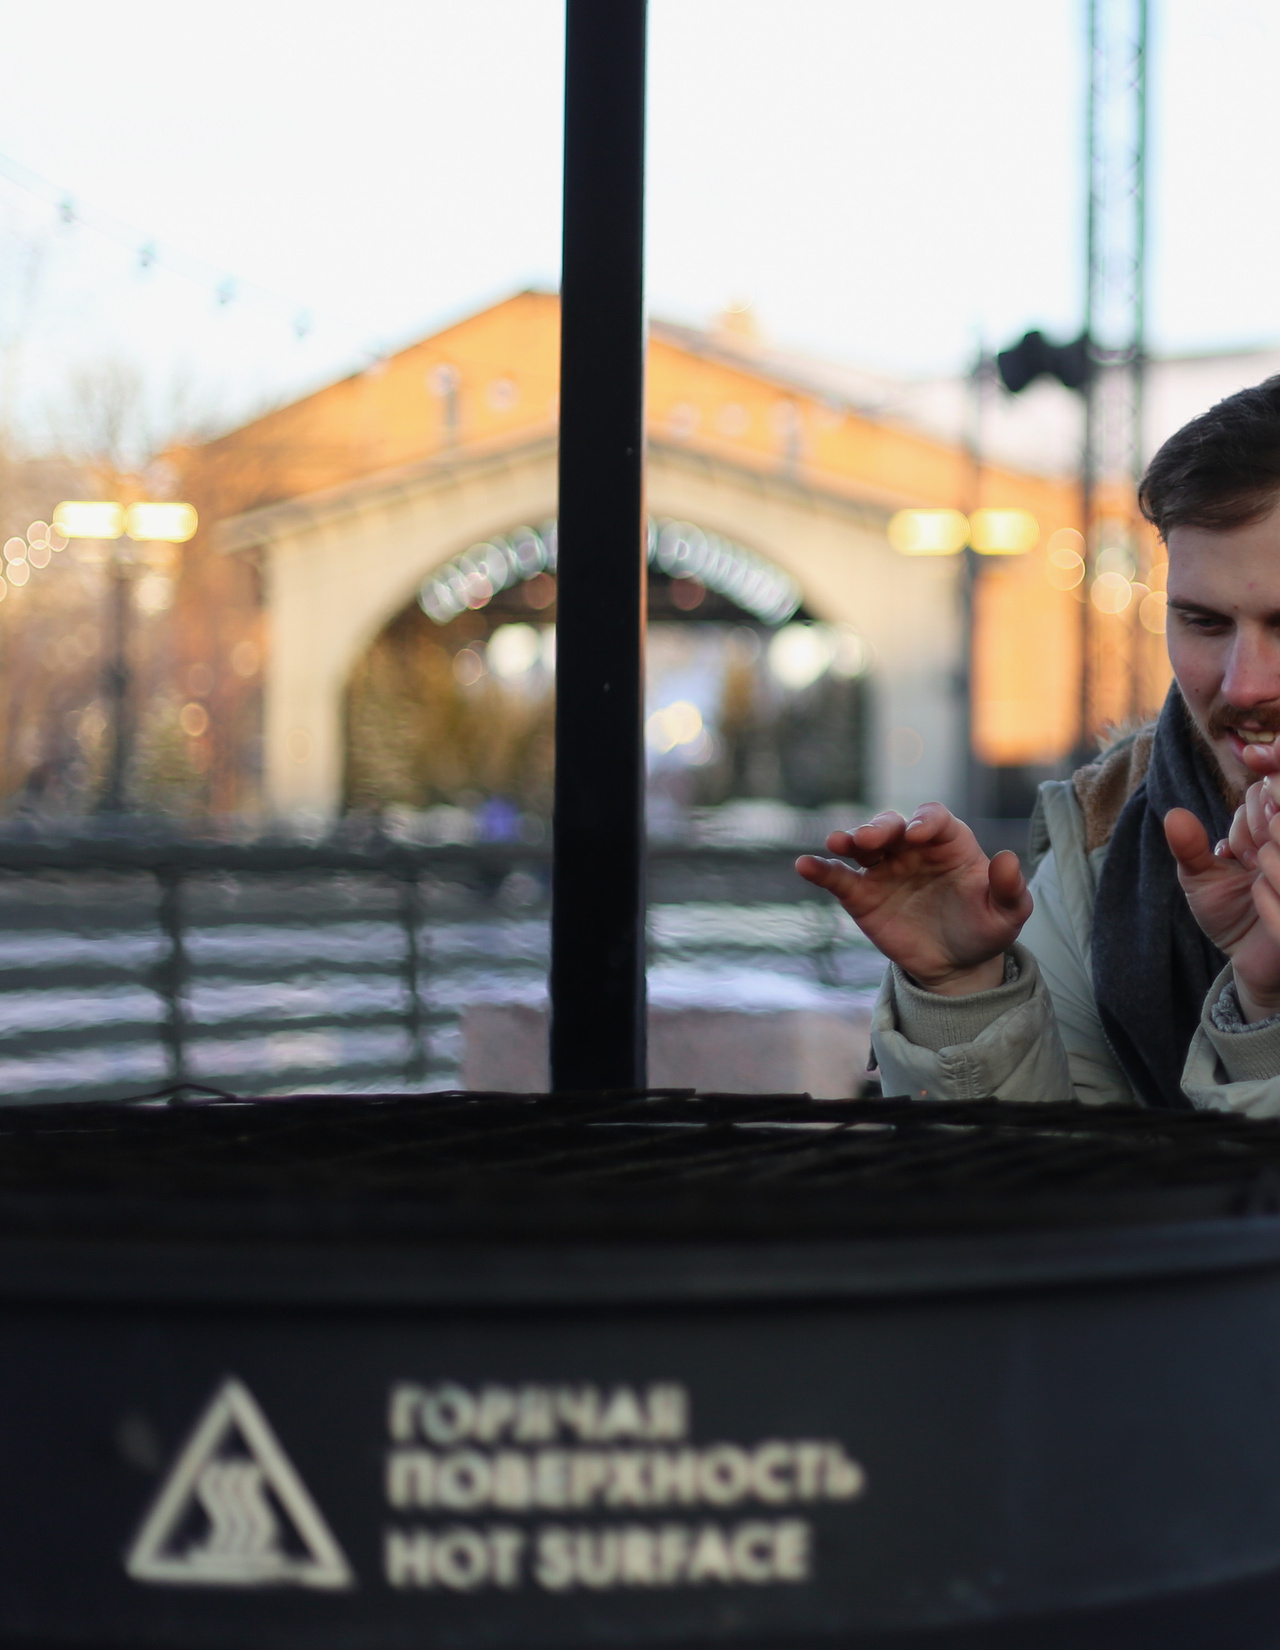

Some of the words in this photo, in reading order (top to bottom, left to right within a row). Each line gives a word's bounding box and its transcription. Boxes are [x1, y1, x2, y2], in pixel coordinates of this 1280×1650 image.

[389, 1383, 688, 1442] ГОРЯЧАЯ
[387, 1441, 864, 1510] ПОВЕРХНОСТЬ
[385, 1527, 524, 1588] HOT
[536, 1519, 809, 1589] SURFACE
